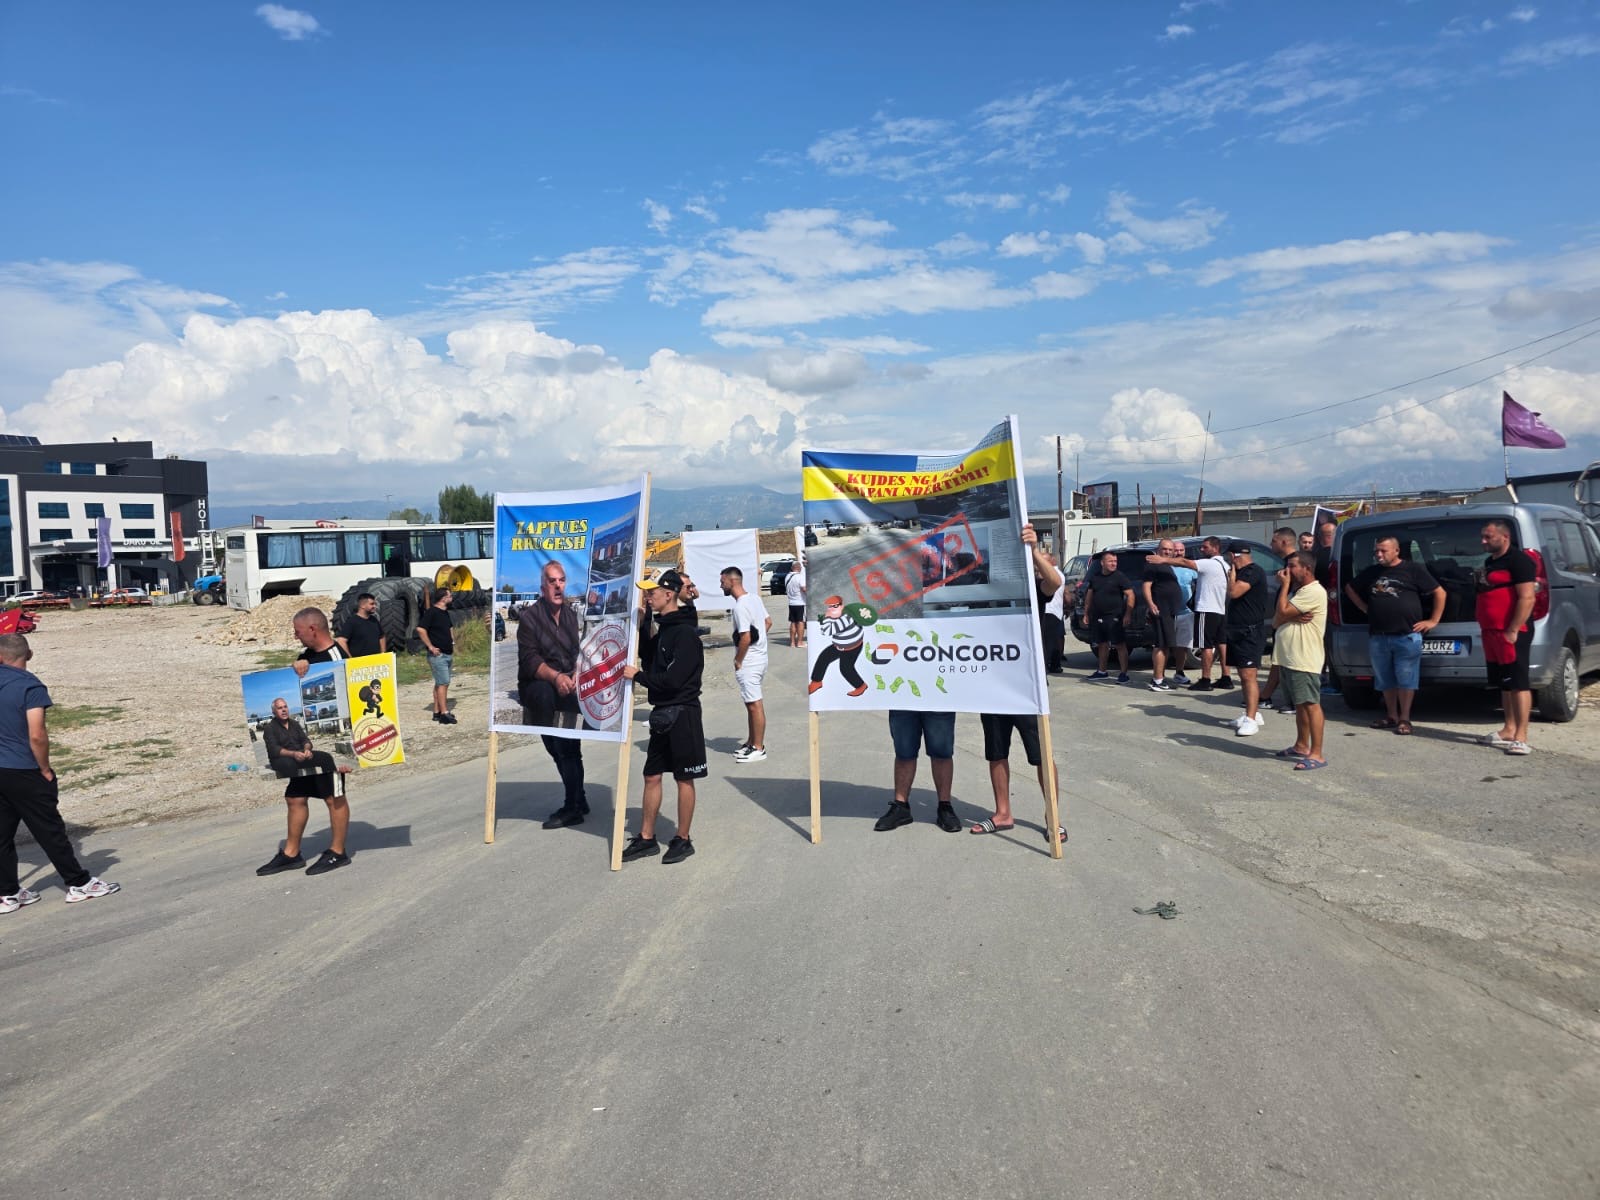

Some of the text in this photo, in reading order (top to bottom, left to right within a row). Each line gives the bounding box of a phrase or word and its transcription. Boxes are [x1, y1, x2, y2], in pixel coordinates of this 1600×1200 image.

[847, 473, 905, 486] KUJDES
[911, 472, 938, 486] NGA
[511, 536, 587, 551] RRUGESH
[903, 644, 1021, 662] CONCORD
[938, 664, 988, 674] GROUP
[580, 678, 596, 692] STOP
